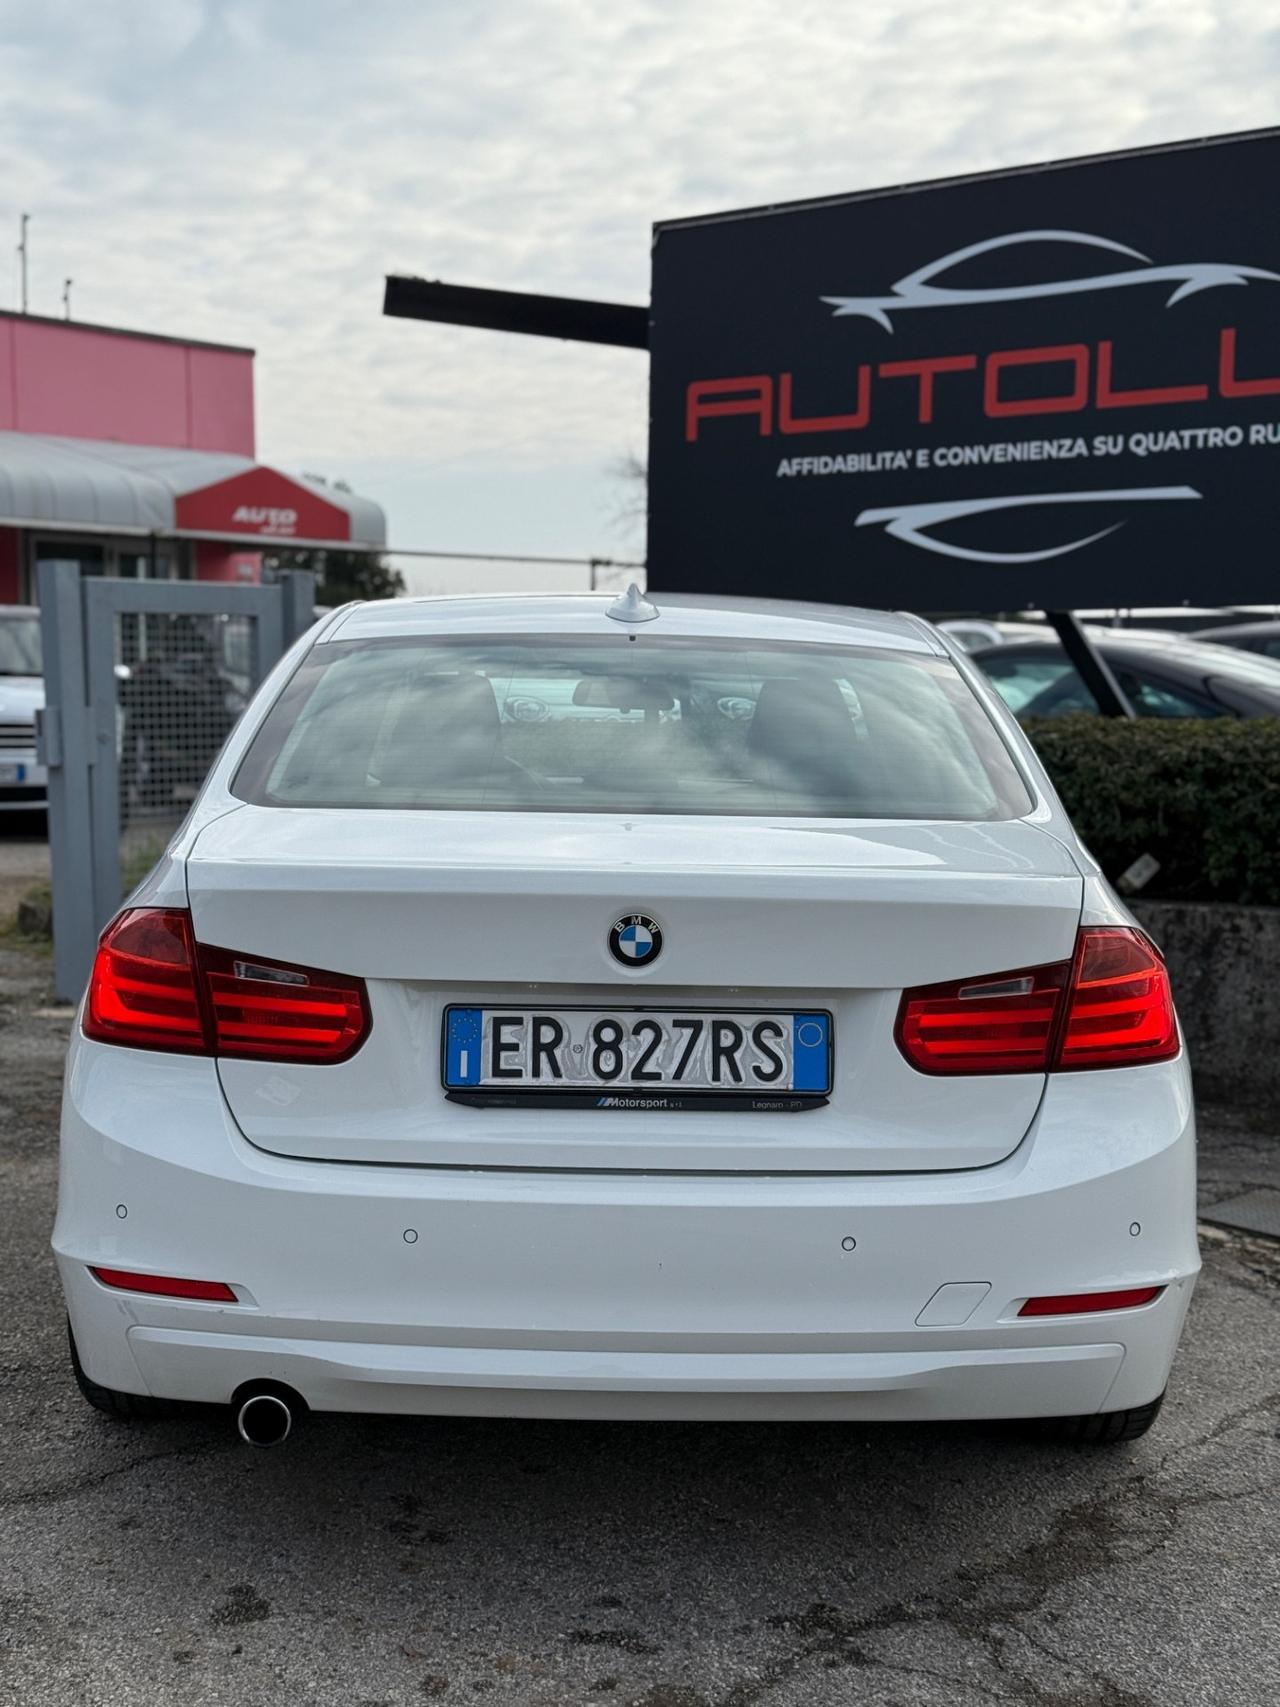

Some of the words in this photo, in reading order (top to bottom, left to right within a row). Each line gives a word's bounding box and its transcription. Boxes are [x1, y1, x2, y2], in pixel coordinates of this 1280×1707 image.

[776, 450, 912, 478] AFFIDABILITA'
[916, 449, 930, 469] E
[933, 437, 1089, 467] CONVENIENZA
[1093, 434, 1123, 456] SU
[1129, 426, 1243, 457] QUATTRO
[614, 916, 660, 933] BMW
[491, 1016, 564, 1079] ER
[599, 1096, 668, 1109] Motorsport
